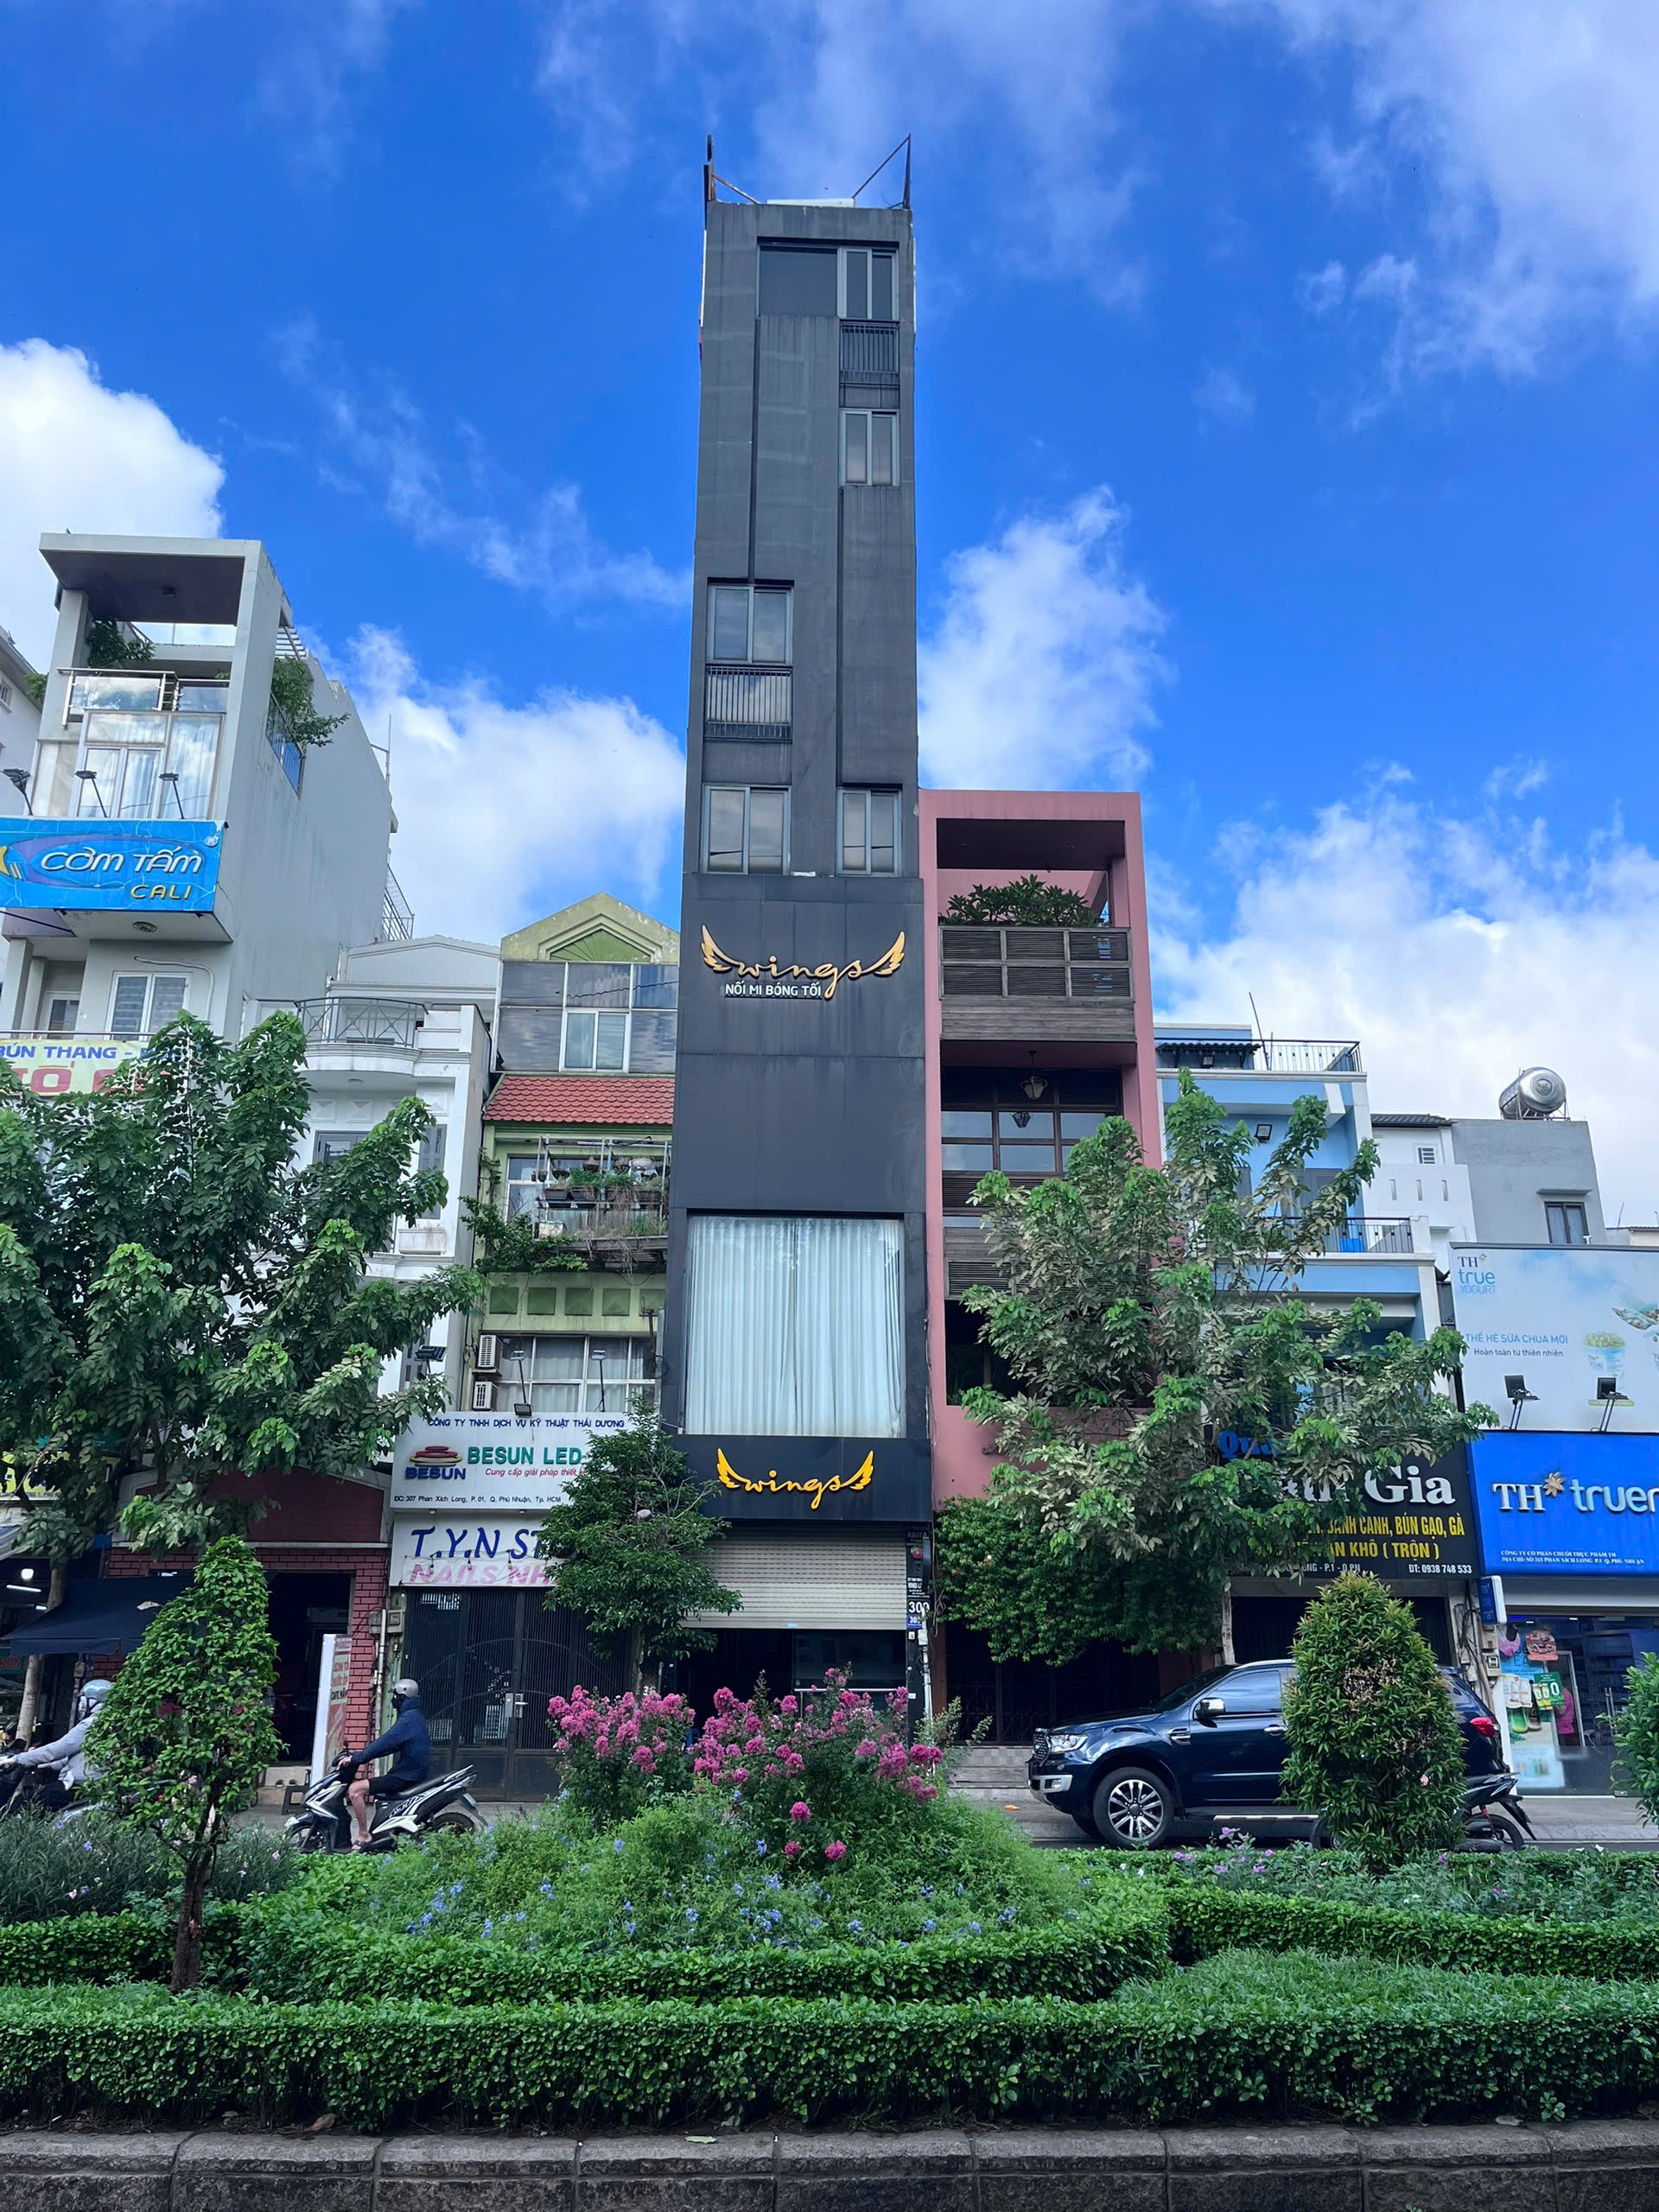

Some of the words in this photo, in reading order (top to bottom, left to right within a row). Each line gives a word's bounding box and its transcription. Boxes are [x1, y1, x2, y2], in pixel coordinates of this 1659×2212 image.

[130, 885, 192, 899] CALI
[725, 980, 747, 995] NỐI
[749, 984, 762, 995] MI
[766, 982, 798, 997] BÓNG
[801, 981, 822, 997] TỐI
[44, 1046, 118, 1059] THANG
[1457, 1256, 1478, 1268] TH
[1458, 1268, 1496, 1285] true
[1460, 1285, 1497, 1294] YOGURT
[1522, 1334, 1549, 1344] CHUA
[429, 1417, 450, 1427] CÔNG
[493, 1419, 512, 1428] DỊCH
[516, 1419, 527, 1428] VỤ
[530, 1418, 542, 1427] KỸ
[545, 1418, 569, 1428] THUẬT
[574, 1418, 592, 1427] THÁI
[594, 1419, 626, 1427] DƯƠNG
[467, 1446, 535, 1465] BESUN
[543, 1446, 583, 1465] LED
[404, 1466, 467, 1480] BESUN
[485, 1467, 505, 1477] Cung
[507, 1467, 522, 1477] cấp
[539, 1468, 559, 1478] pháp
[1363, 1465, 1457, 1505] Gia
[1492, 1483, 1547, 1511] TH
[1395, 1512, 1419, 1535] BÚN
[1448, 1512, 1465, 1536] GÀ
[1349, 1539, 1378, 1558] KHÔ
[1391, 1539, 1430, 1561] TRỘN
[410, 1564, 499, 1584] NAILS
[1421, 1564, 1440, 1573] 0938
[1442, 1565, 1456, 1573] 748
[1457, 1565, 1472, 1573] 533
